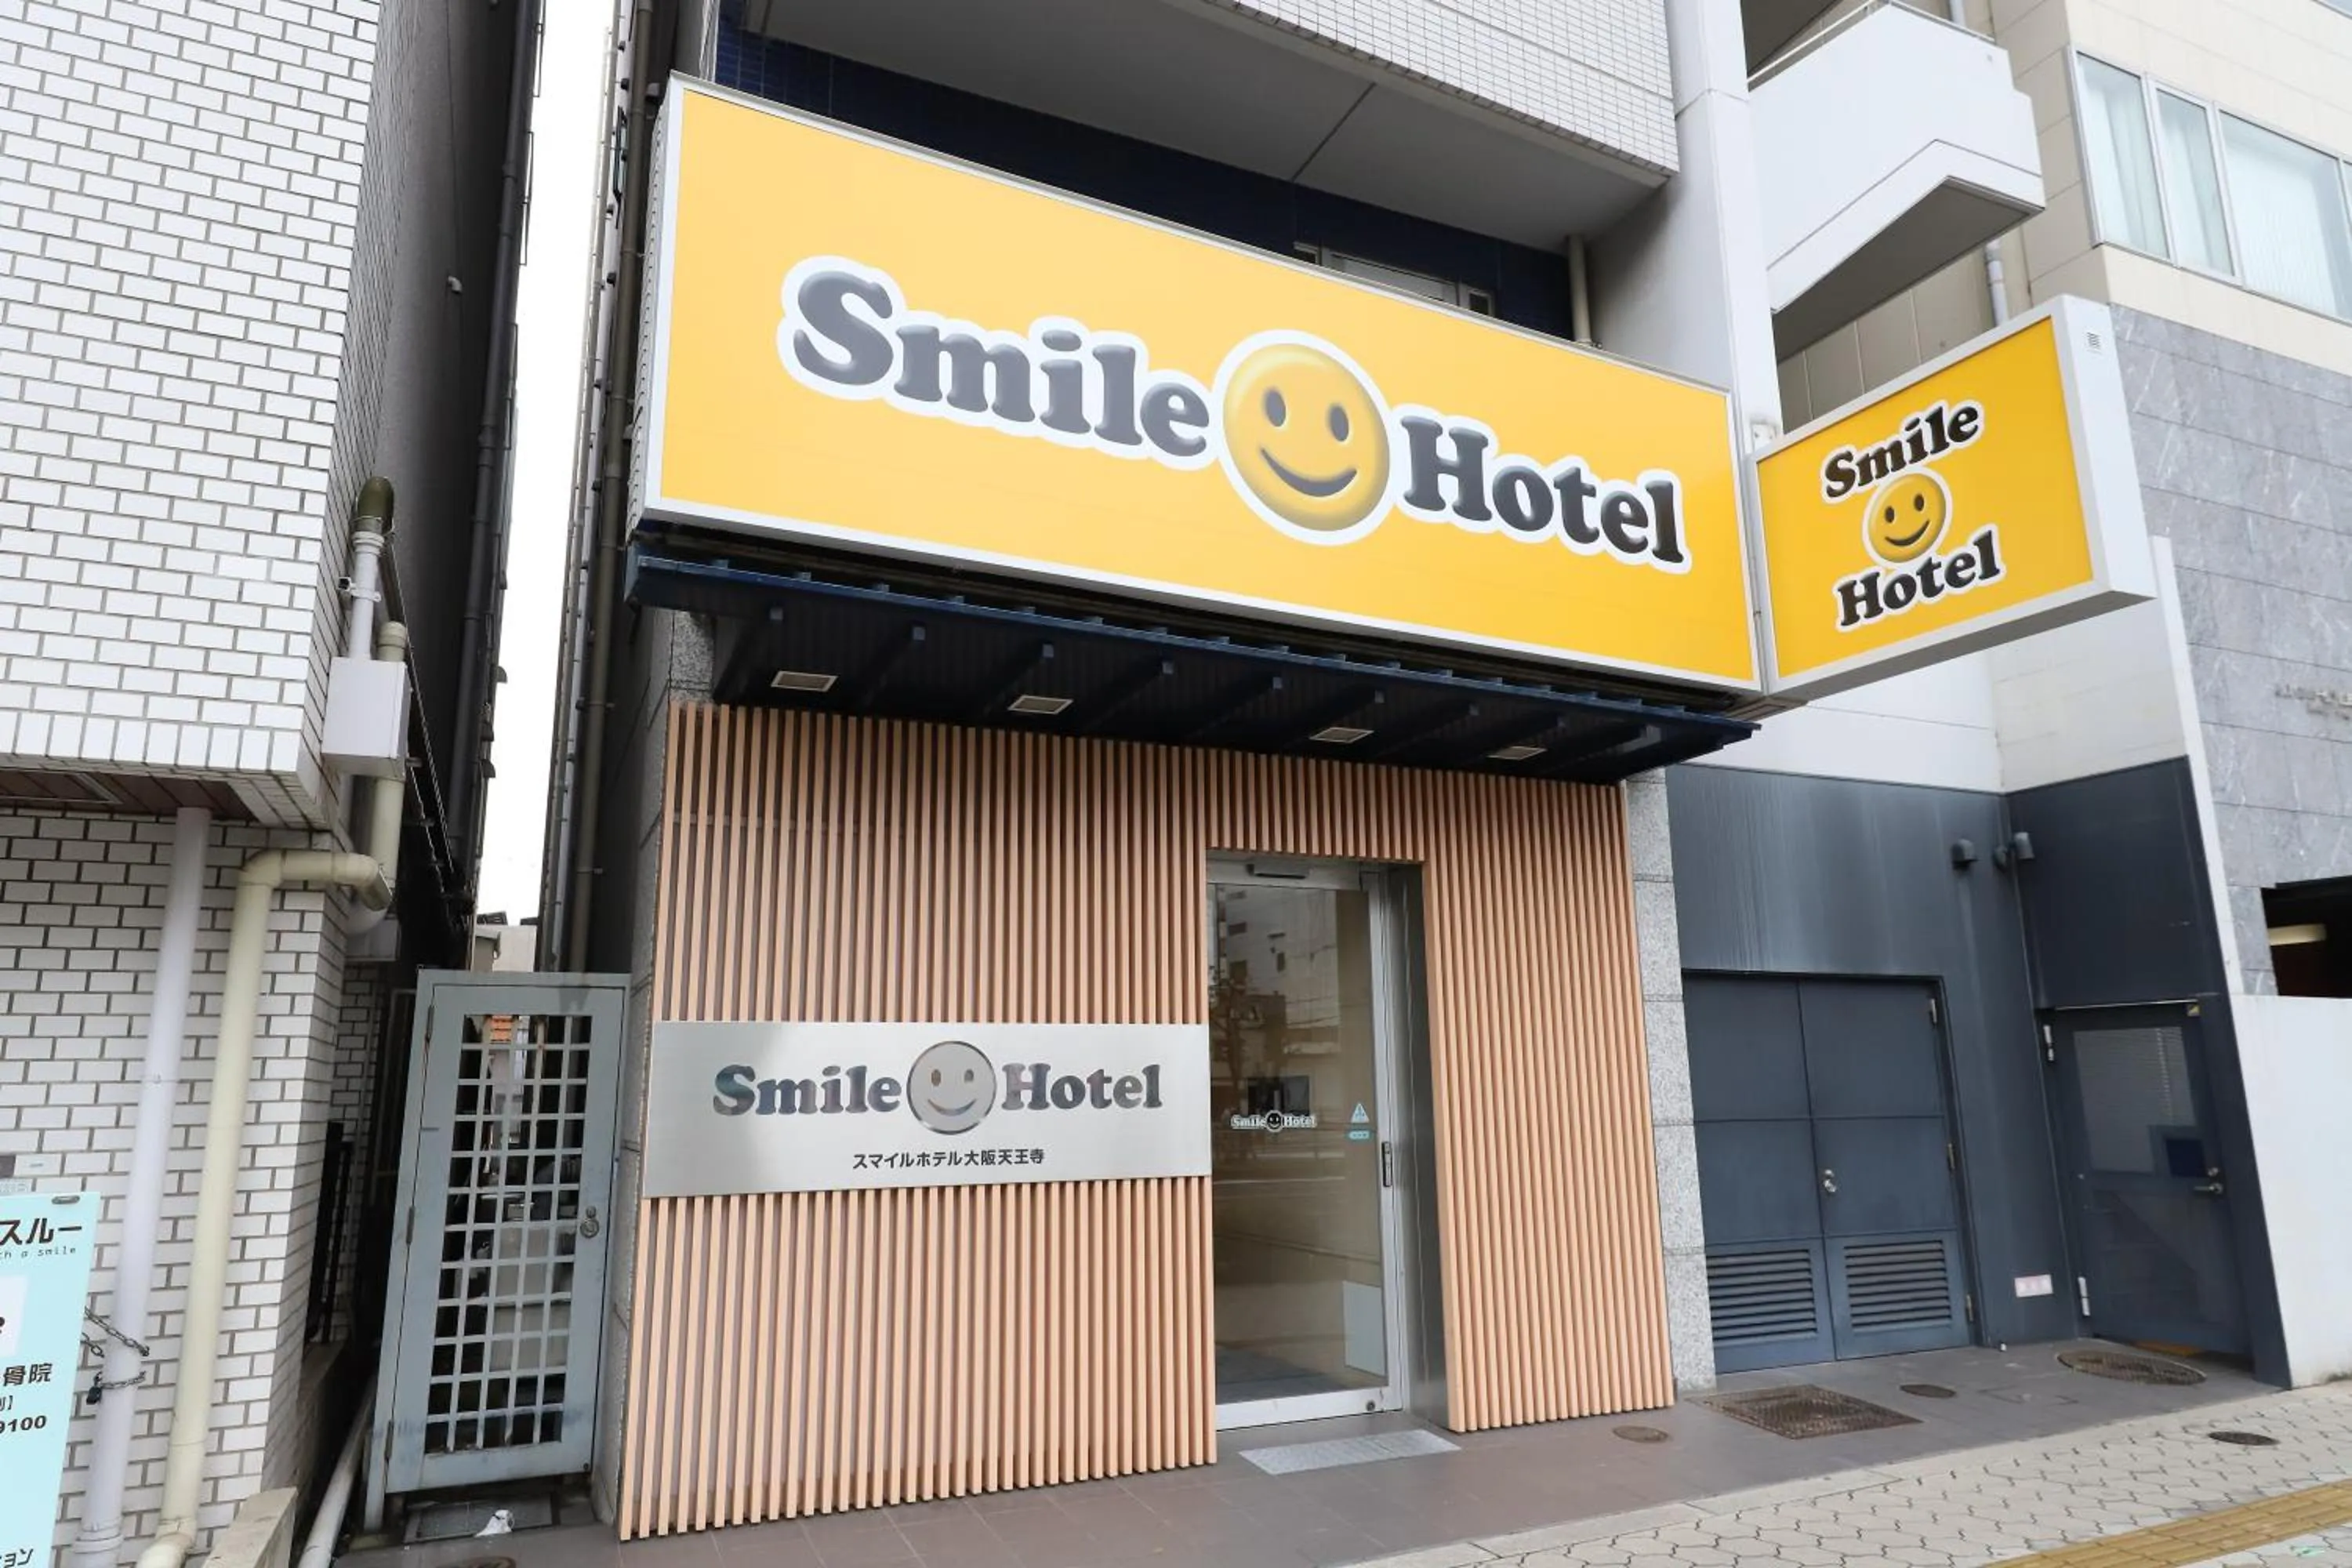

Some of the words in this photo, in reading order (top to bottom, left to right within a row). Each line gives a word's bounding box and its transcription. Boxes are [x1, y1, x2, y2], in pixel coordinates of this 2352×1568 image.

[793, 270, 1210, 457] Smile
[1399, 415, 1685, 564] Hotel
[1824, 405, 1980, 499] Smile
[1835, 529, 2001, 627] Hotel
[712, 1064, 902, 1116] Smile
[1001, 1062, 1163, 1109] Hotel
[1231, 1114, 1265, 1129] Smile
[1283, 1113, 1317, 1127] Hotel
[853, 1149, 1044, 1169] スマイルホテル大阪天王寺
[0, 1218, 82, 1245] スルー
[38, 1246, 76, 1256] smile
[0, 1363, 53, 1387] 骨院
[0, 1548, 34, 1568] ョン
